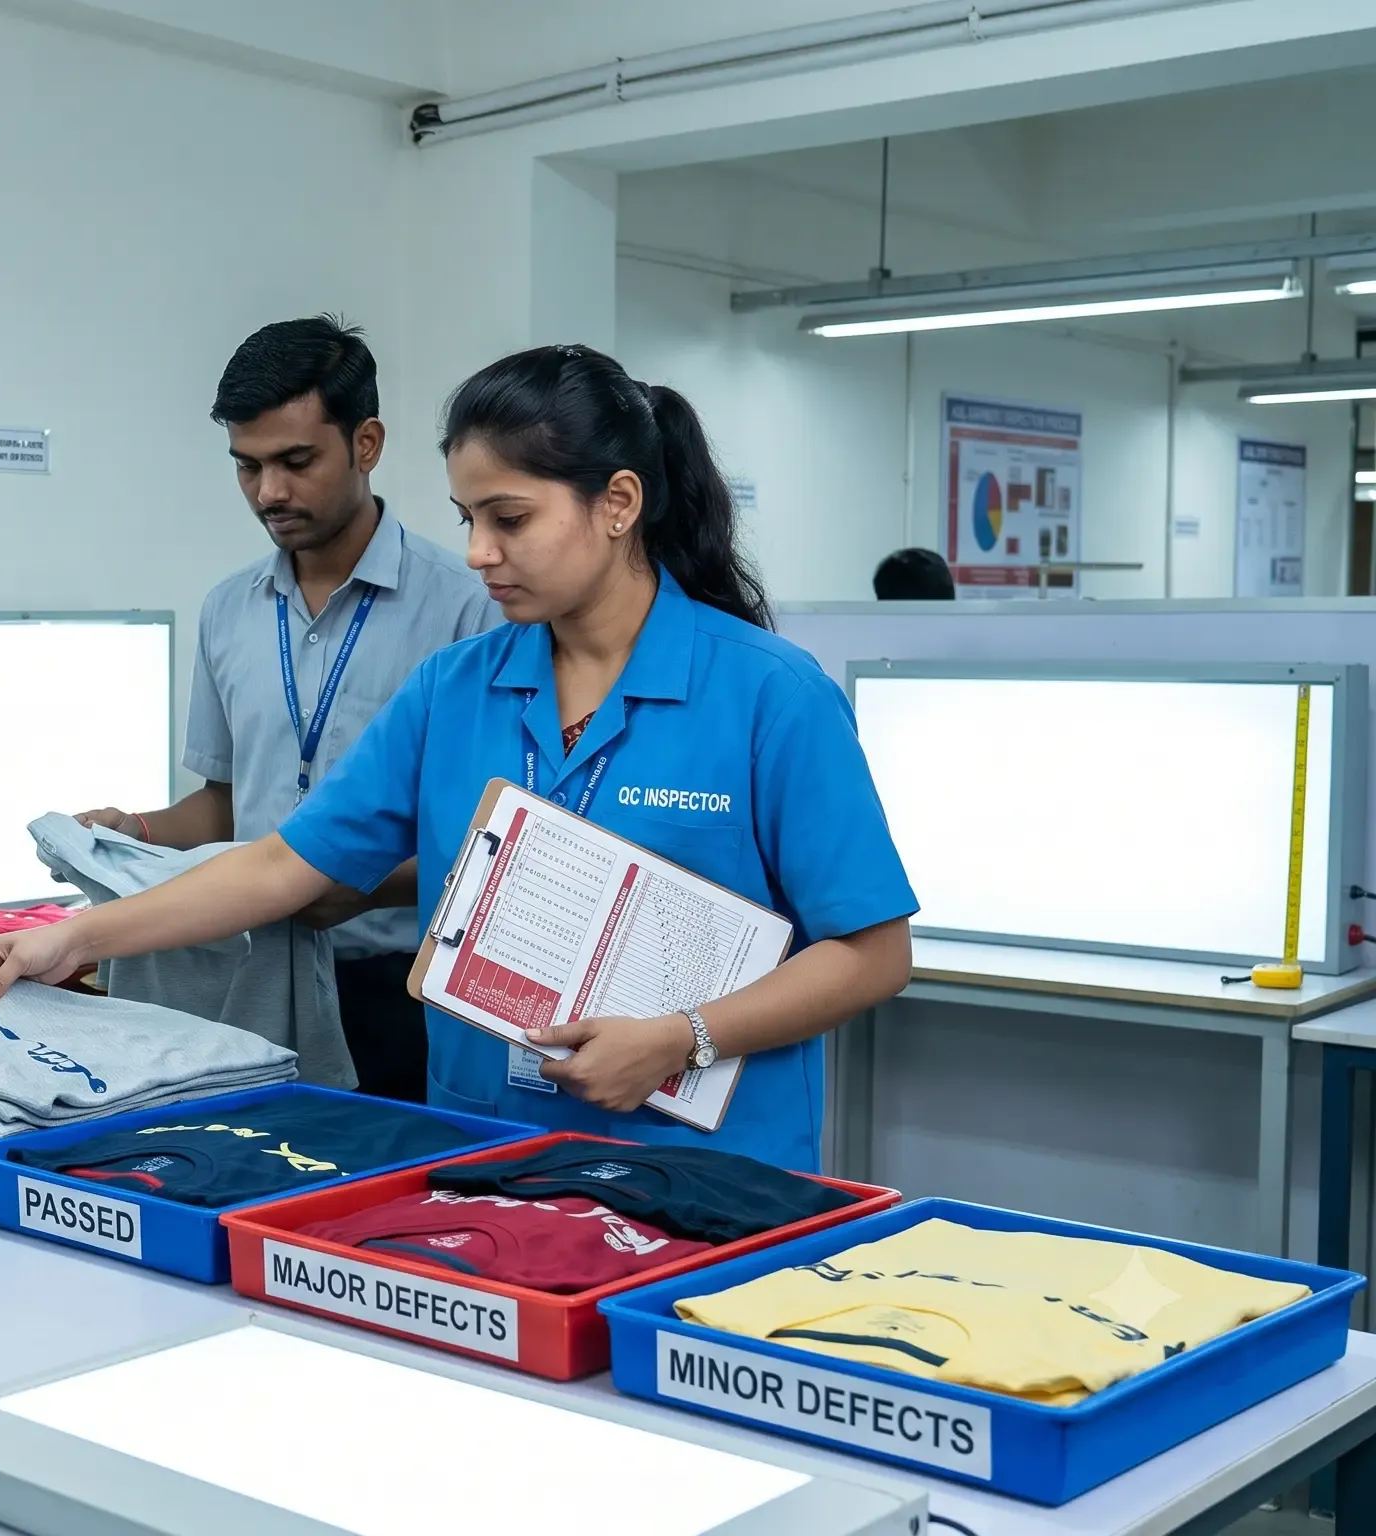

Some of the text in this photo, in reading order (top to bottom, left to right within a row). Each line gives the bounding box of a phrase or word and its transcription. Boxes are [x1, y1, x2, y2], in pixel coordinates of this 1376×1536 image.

[619, 786, 730, 812] QC INSPECTOR
[25, 1187, 135, 1245] PASSED
[272, 1253, 508, 1341] MAJOR DEFECTS
[669, 1348, 975, 1456] MINOR DEFECTS
